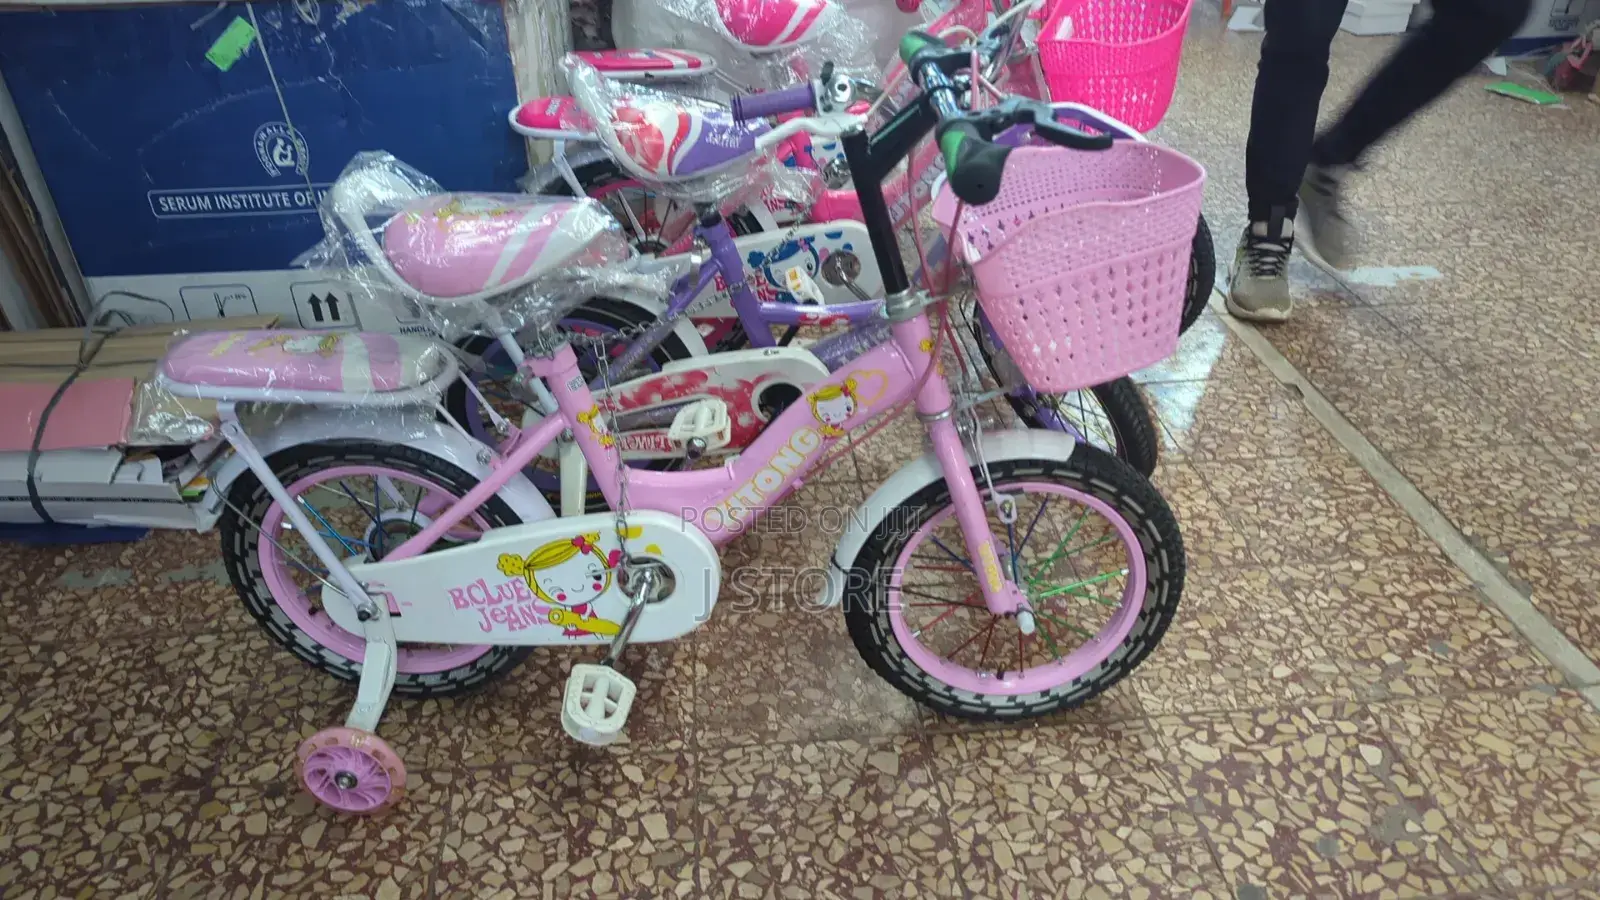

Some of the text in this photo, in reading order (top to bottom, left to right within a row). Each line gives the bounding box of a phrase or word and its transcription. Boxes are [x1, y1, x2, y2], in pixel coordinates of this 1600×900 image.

[159, 196, 212, 212] SERUM
[216, 193, 291, 210] INSTITUTE
[294, 191, 313, 206] OF
